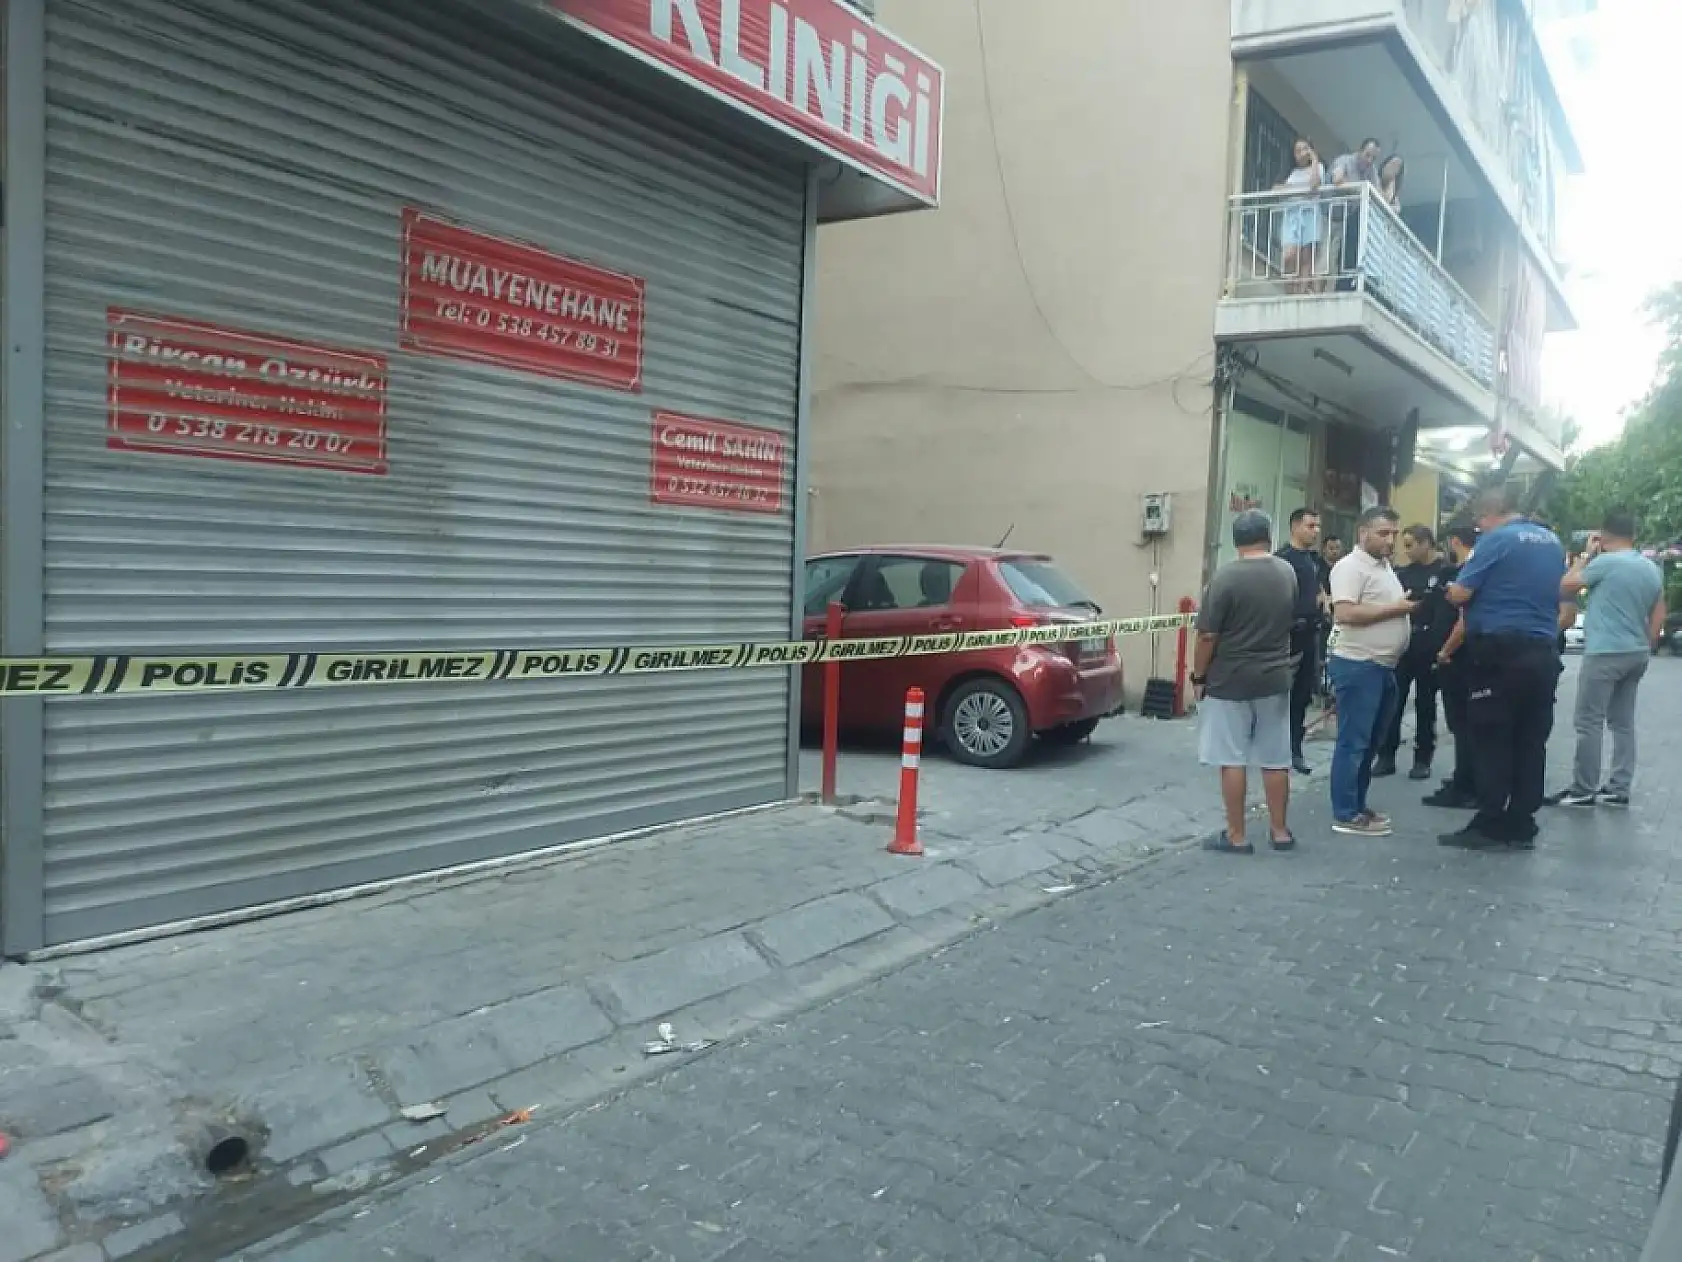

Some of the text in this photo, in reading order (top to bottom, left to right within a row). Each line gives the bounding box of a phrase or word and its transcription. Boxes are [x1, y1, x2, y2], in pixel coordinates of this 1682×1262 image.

[420, 251, 632, 333] MUAYENEHANE
[435, 299, 619, 357] Tel: 0 538 457 89 31
[148, 411, 352, 454] 0 538 218 20 07
[0, 664, 73, 691] EZ
